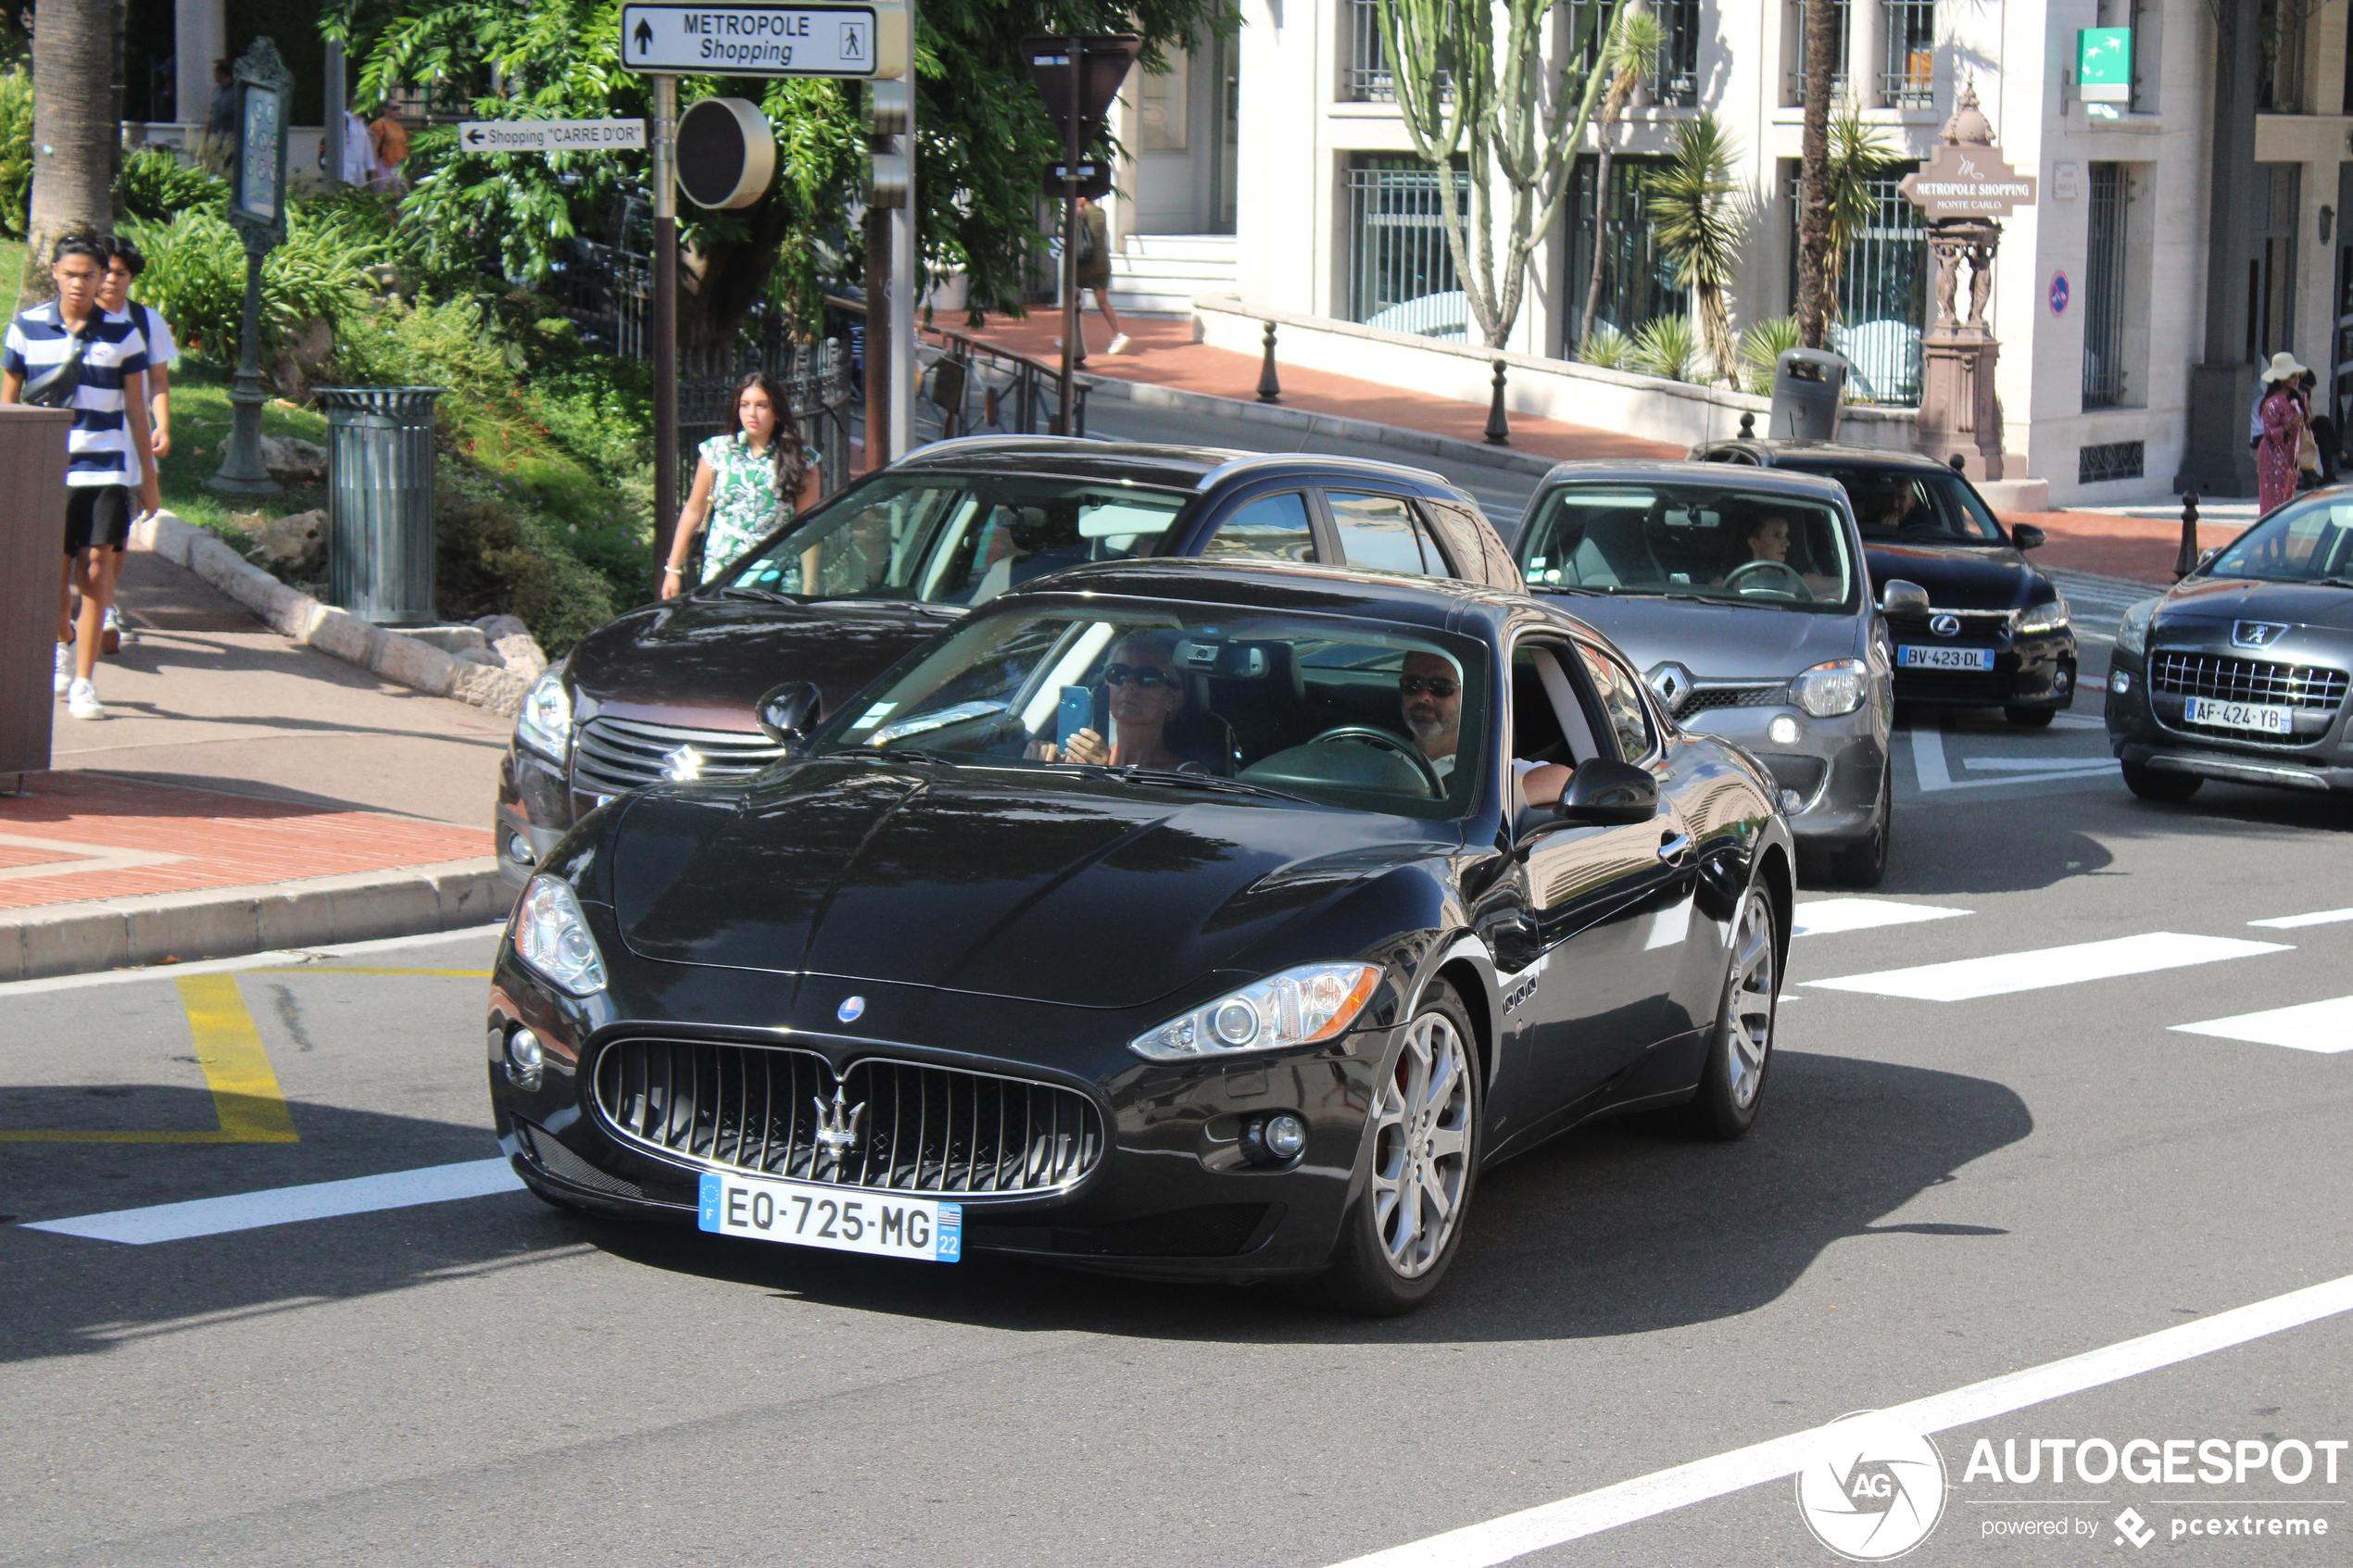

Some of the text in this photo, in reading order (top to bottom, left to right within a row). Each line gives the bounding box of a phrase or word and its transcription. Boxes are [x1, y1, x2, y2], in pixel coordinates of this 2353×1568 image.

[683, 13, 810, 37] METROPOLE
[699, 37, 793, 66] Shopping
[488, 129, 545, 146] Shopping
[547, 127, 600, 143] "CARRE
[1916, 182, 2030, 197] METROPOLE SHOPPING
[1936, 200, 2002, 210] MONTE CARLO
[1907, 648, 1982, 667] BV-423-DL
[2196, 702, 2279, 728] AF-424-YB
[705, 1208, 713, 1221] F
[727, 1186, 930, 1248] EQ-725-MG
[938, 1235, 958, 1255] 22
